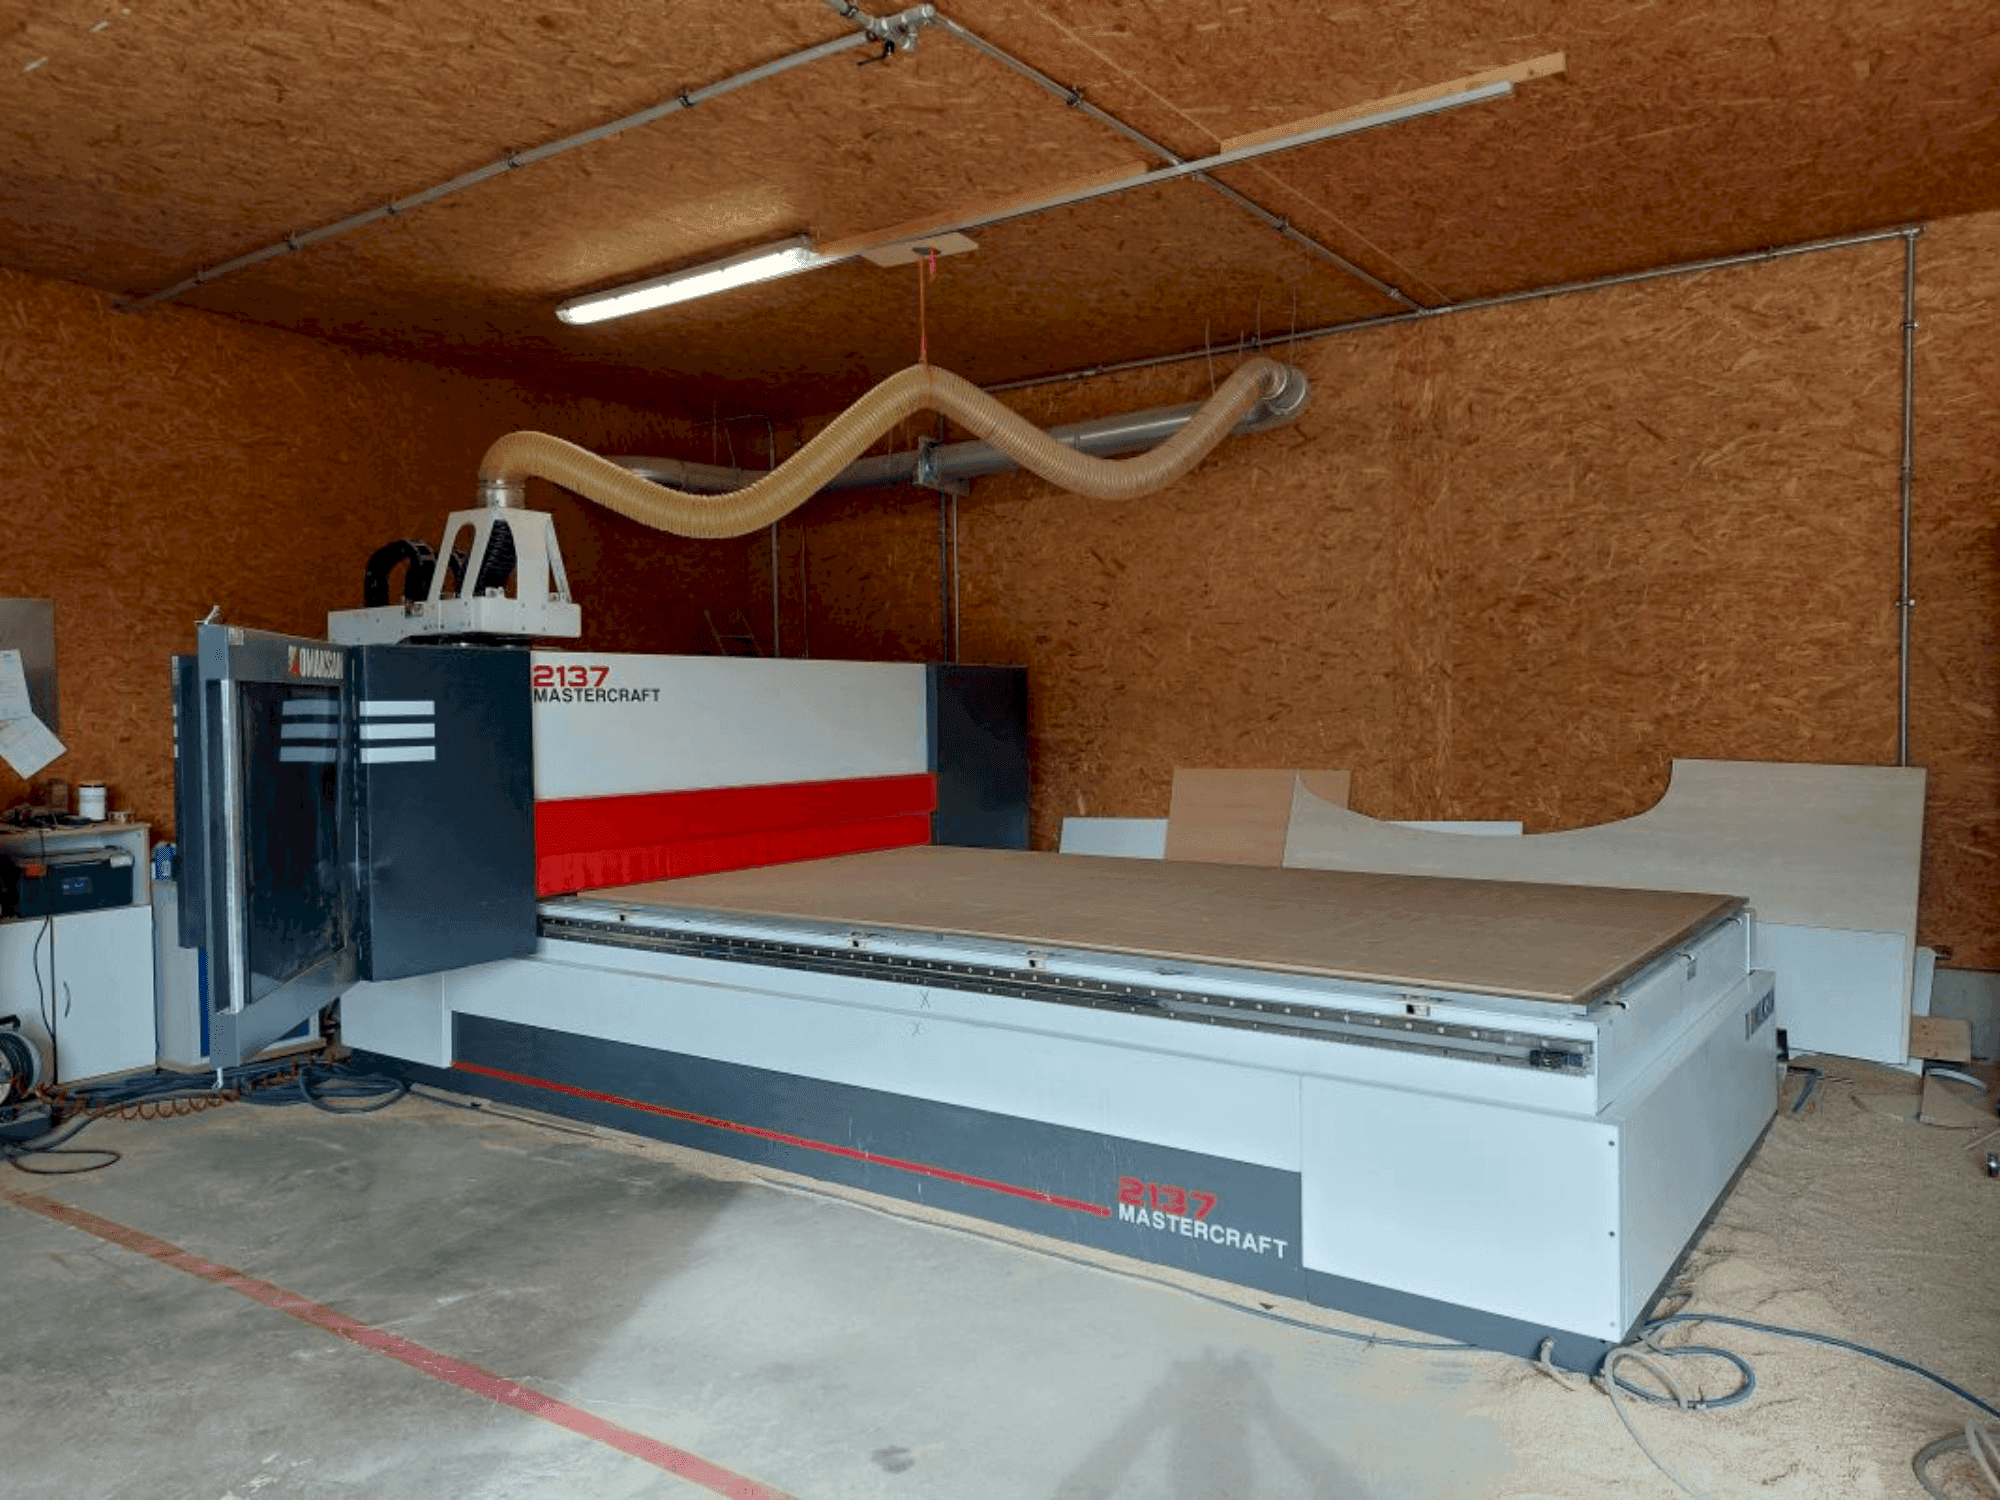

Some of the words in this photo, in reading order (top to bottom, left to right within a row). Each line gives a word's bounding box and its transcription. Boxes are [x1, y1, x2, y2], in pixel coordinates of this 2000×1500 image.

[532, 665, 610, 687] 2137
[533, 688, 660, 702] MASTERCRAFT
[1118, 1175, 1218, 1221] 2137
[1118, 1203, 1288, 1259] MASTERCRAFT
